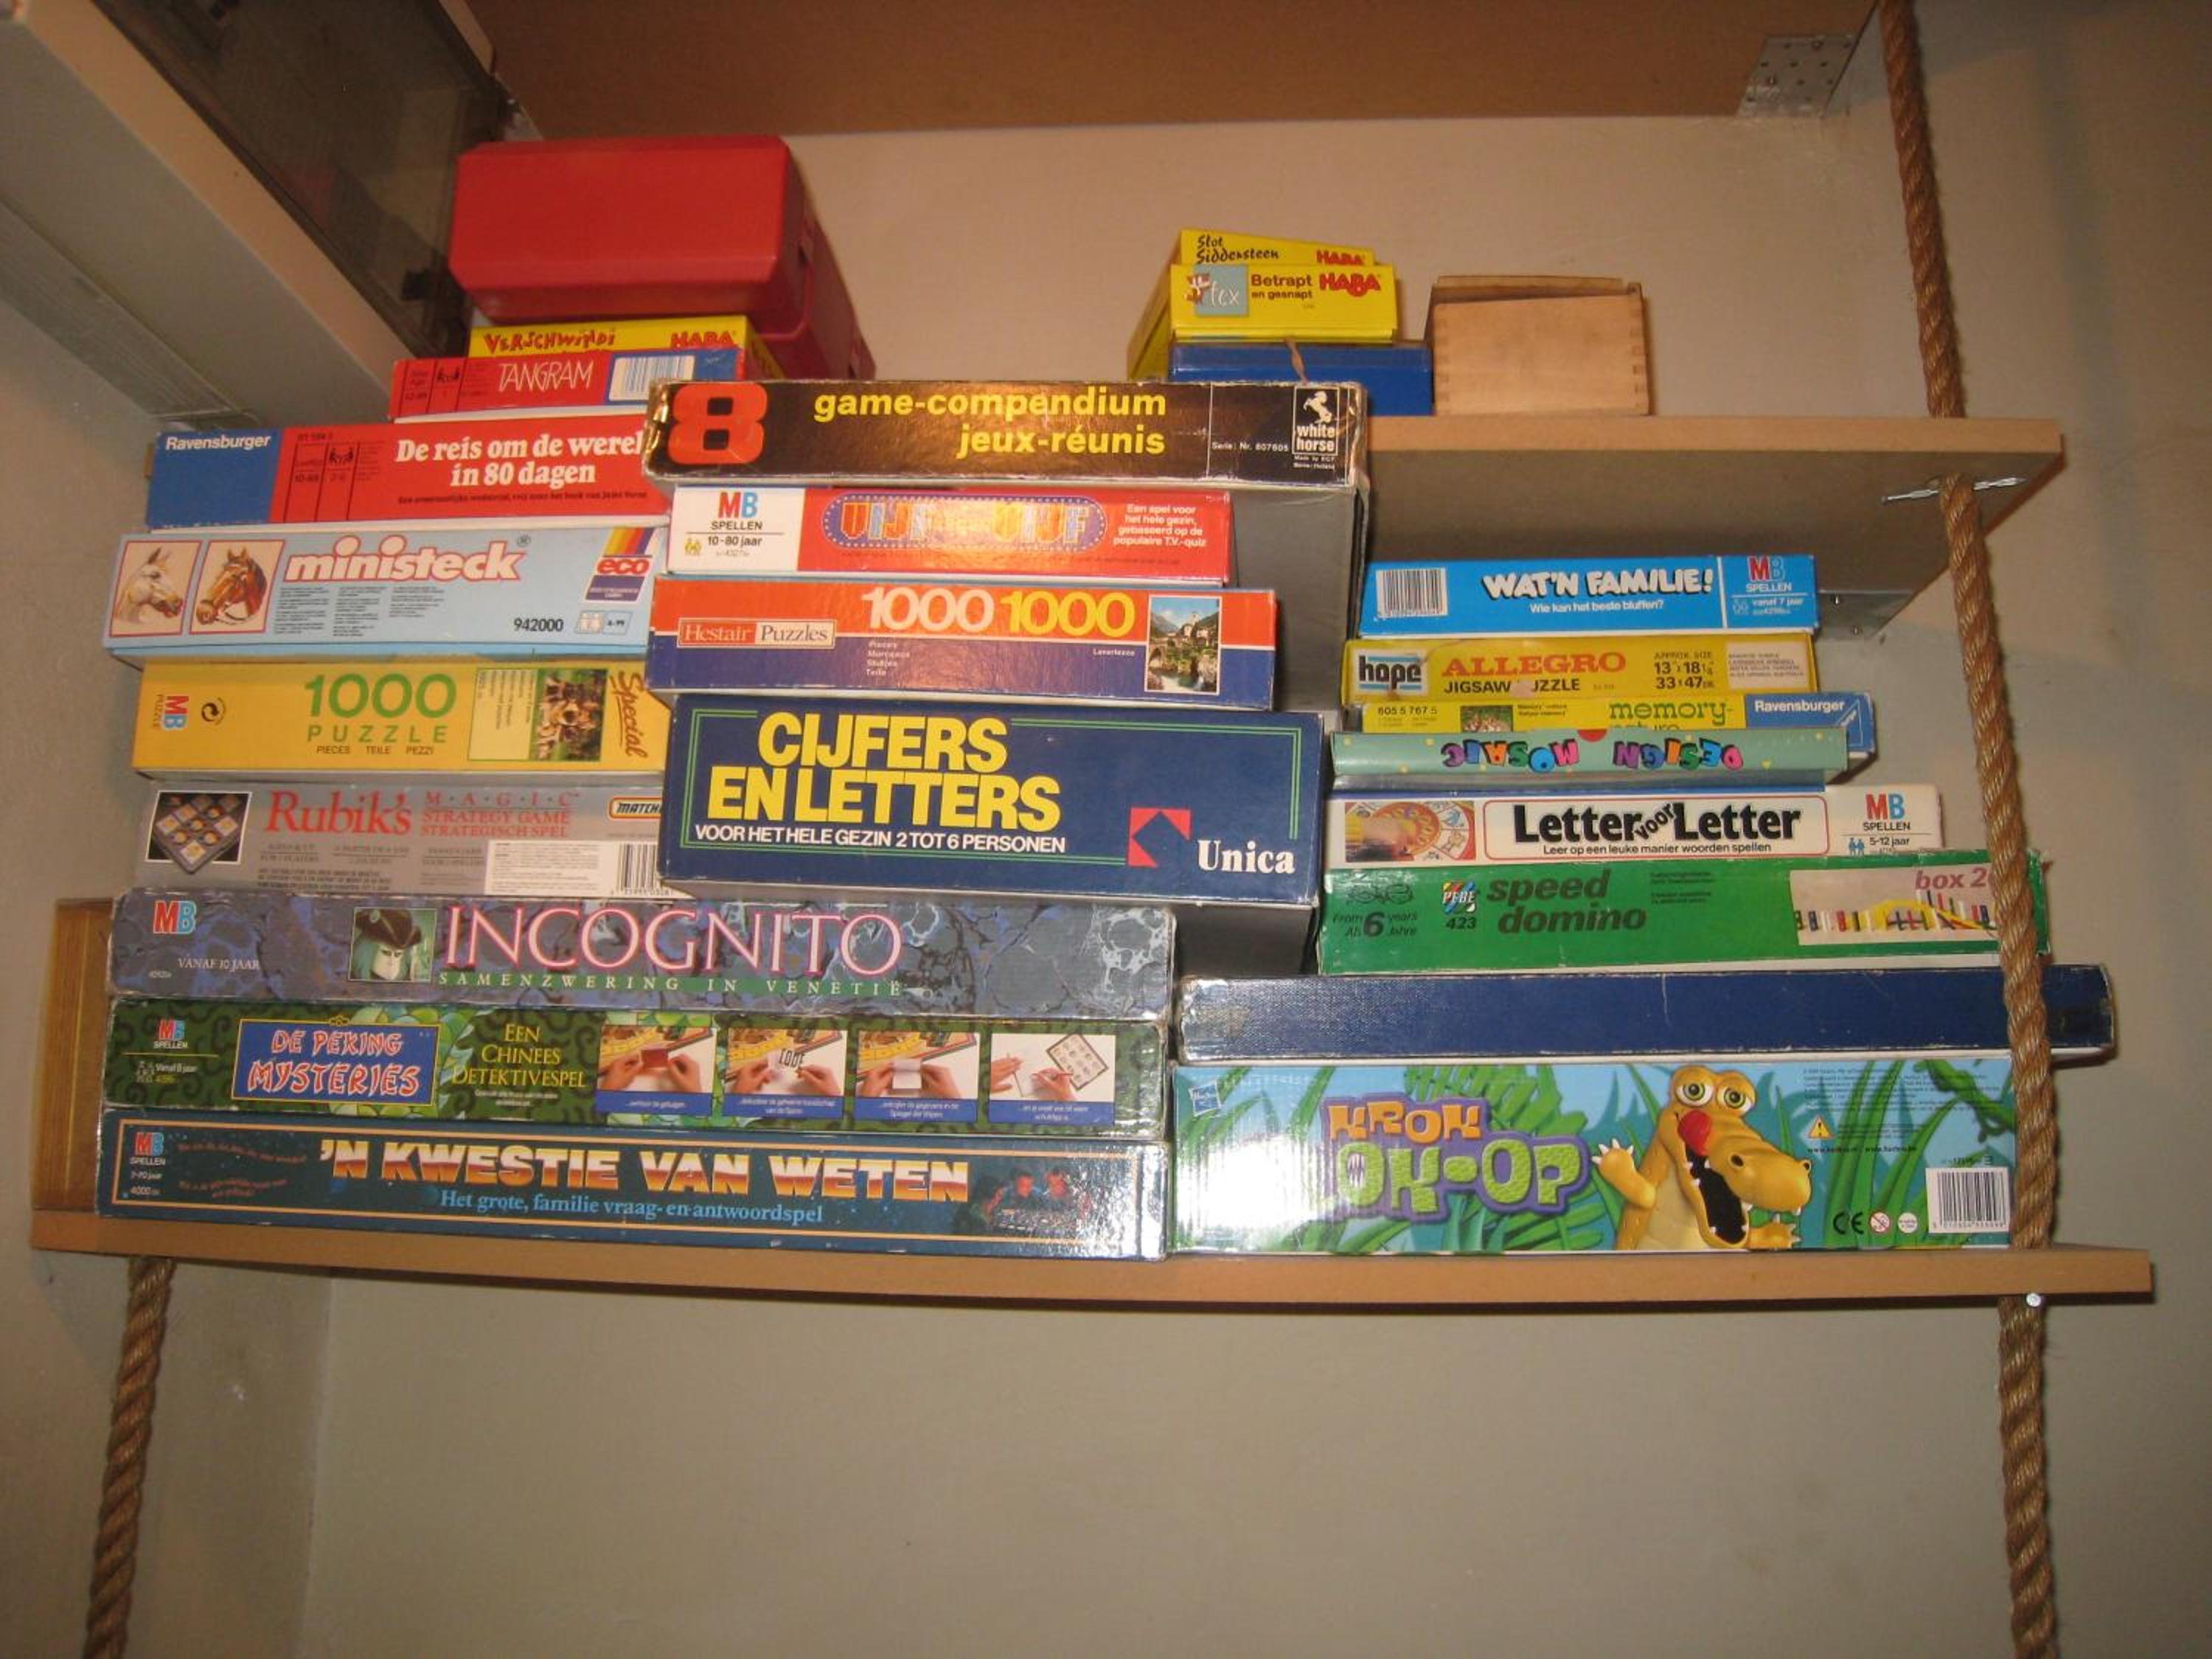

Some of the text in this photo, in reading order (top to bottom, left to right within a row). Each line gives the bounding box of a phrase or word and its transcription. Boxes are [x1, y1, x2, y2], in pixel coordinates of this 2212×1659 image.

[1197, 234, 1224, 249] Slot
[1316, 250, 1364, 265] HABA
[1251, 274, 1312, 288] Betrapt
[1319, 273, 1382, 298] HABA
[1267, 291, 1312, 301] gesnapt
[671, 330, 734, 349] HABA
[497, 359, 593, 392] TANGRAM
[814, 387, 1166, 422] game-compendium
[667, 383, 768, 465] 8
[1297, 424, 1335, 438] white
[165, 434, 271, 451] Ravensburger
[395, 439, 428, 462] De
[433, 437, 482, 462] reis
[487, 440, 527, 459] om
[532, 434, 563, 457] de
[569, 430, 644, 456] werel
[956, 423, 1166, 459] jeux-réunis
[1296, 437, 1335, 451] horse
[451, 460, 596, 490] in 80 dagen
[717, 491, 759, 518] MB
[1127, 504, 1196, 515] Een spel voor
[710, 520, 762, 531] SPELLEN
[1124, 515, 1141, 524] het
[1143, 515, 1165, 524] hele
[1175, 528, 1188, 537] op
[1190, 526, 1203, 535] de
[740, 535, 762, 548] jaar
[282, 535, 525, 583] ministeck
[597, 557, 650, 576] eco
[1747, 555, 1787, 582] MB
[1482, 568, 1714, 599] WAT'N FAMILIE!
[1745, 582, 1792, 592] SPELLEN
[862, 586, 1136, 637] 1000 1000
[1530, 599, 1664, 613] Wie kan het beste bluffen?
[513, 617, 564, 633] 942000
[685, 624, 828, 643] Hestair Puzzles
[1359, 655, 1423, 691] hope
[1441, 650, 1626, 678] ALLEGRO
[304, 672, 457, 719] 1000
[1443, 680, 1512, 694] JIGSAW
[1656, 676, 1676, 689] 33
[164, 695, 189, 730] MB
[609, 669, 649, 759] Special
[1609, 700, 1728, 726] memory
[1753, 699, 1846, 714] Ravensburger
[306, 724, 449, 743] PUZZLE
[758, 712, 1009, 773] CIJFERS
[316, 745, 350, 755] PIECES
[365, 745, 391, 755] TEILE
[1440, 737, 1744, 773] DESIGN MOSAIC
[707, 765, 1062, 832] EN LETTERS
[1865, 793, 1905, 820] MB
[265, 789, 413, 837] Rubik's
[518, 811, 571, 824] GAME
[1514, 801, 1801, 843] Letter voor Letter
[695, 824, 1066, 854] VOOR HET HELE GEZIN 2 TOT 6 PERSONEN
[1862, 821, 1911, 832] SPELLEN
[1543, 842, 1772, 857] Leer op een leuke manier woorden spellen
[1869, 836, 1910, 848] 5-12 jaar
[1197, 839, 1296, 874] Unica
[1486, 869, 1611, 905] speed
[1916, 869, 1965, 890] box
[153, 900, 197, 935] MB
[1364, 911, 1386, 938] 6
[1445, 916, 1475, 930] 423
[1497, 901, 1647, 936] domino
[444, 903, 902, 978] INCOGNITO
[231, 959, 260, 973] JAAR
[438, 973, 680, 991] SAMENZWERING
[707, 979, 737, 992] IN
[159, 1018, 186, 1040] MB
[504, 1023, 542, 1043] EEN
[271, 1029, 403, 1056] DE PEKING
[481, 1044, 563, 1065] CHINEES
[246, 1059, 420, 1098] MYSTERIES
[451, 1068, 588, 1088] DETEKTIVESPEL
[1327, 1099, 1482, 1144] KROK
[134, 1131, 164, 1157] MB
[381, 1141, 620, 1191] KWESTIE
[639, 1150, 750, 1195] VAN
[768, 1155, 969, 1203] WETEN
[1335, 1138, 1582, 1215] OK-OP
[441, 1189, 473, 1208] Het
[477, 1194, 528, 1216] grote,
[534, 1193, 599, 1213] familie
